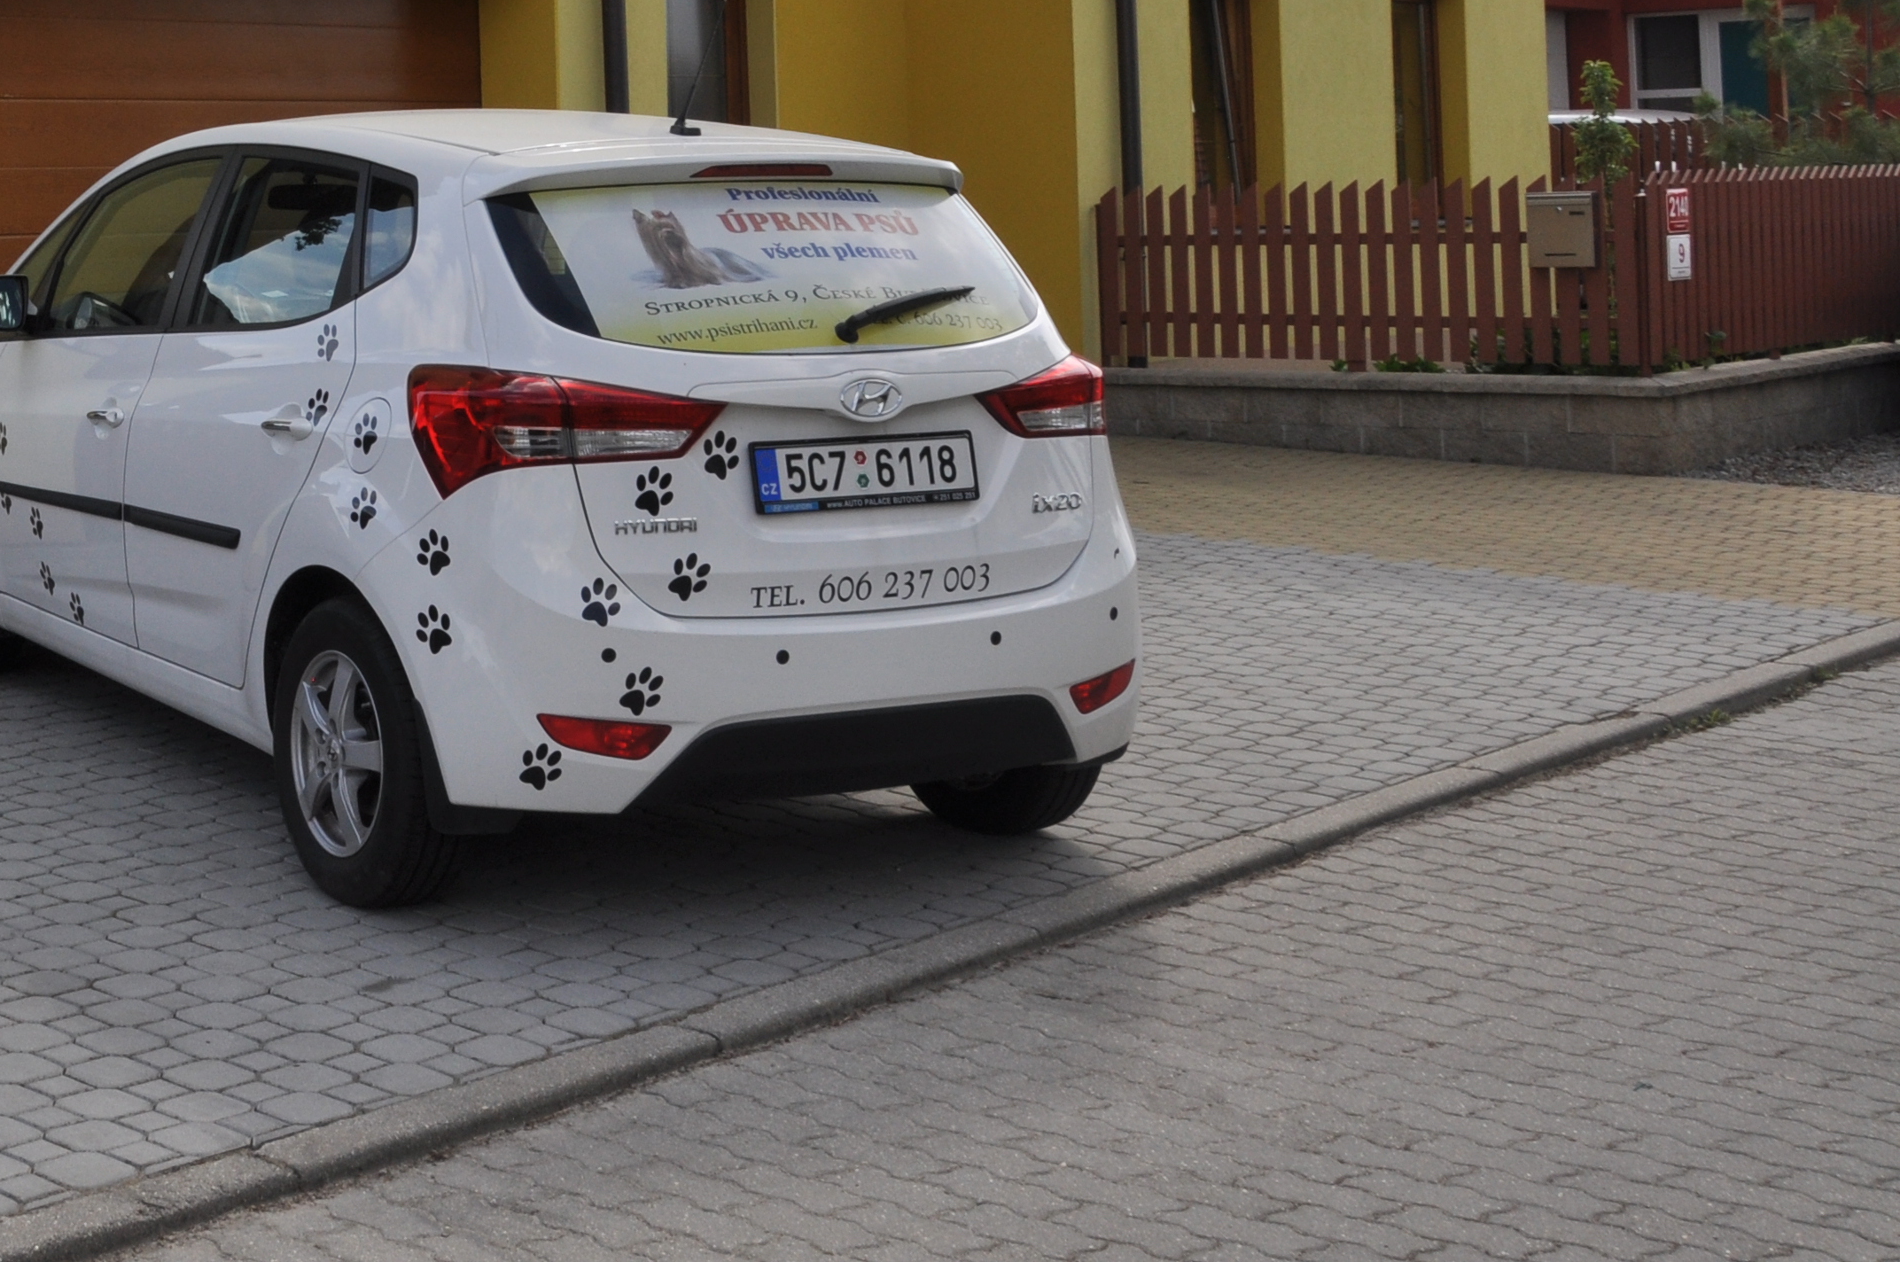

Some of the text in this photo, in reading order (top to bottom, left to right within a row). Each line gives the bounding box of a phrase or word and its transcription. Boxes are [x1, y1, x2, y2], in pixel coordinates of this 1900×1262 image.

[725, 187, 880, 203] Profesionální
[716, 208, 919, 236] ÚPRAVA PSŮ
[761, 242, 919, 261] všech plemen
[1678, 243, 1685, 263] 9
[784, 289, 807, 303] 9,
[948, 313, 973, 329] 237
[657, 317, 818, 345] www.psistrihani.cz
[785, 445, 958, 494] 5C7 6118
[761, 483, 779, 496] CZ
[864, 497, 891, 506] PALACE
[1031, 492, 1083, 514] ix20
[614, 517, 697, 536] HYUNDAI
[751, 562, 991, 608] TEL. 606 237 003
